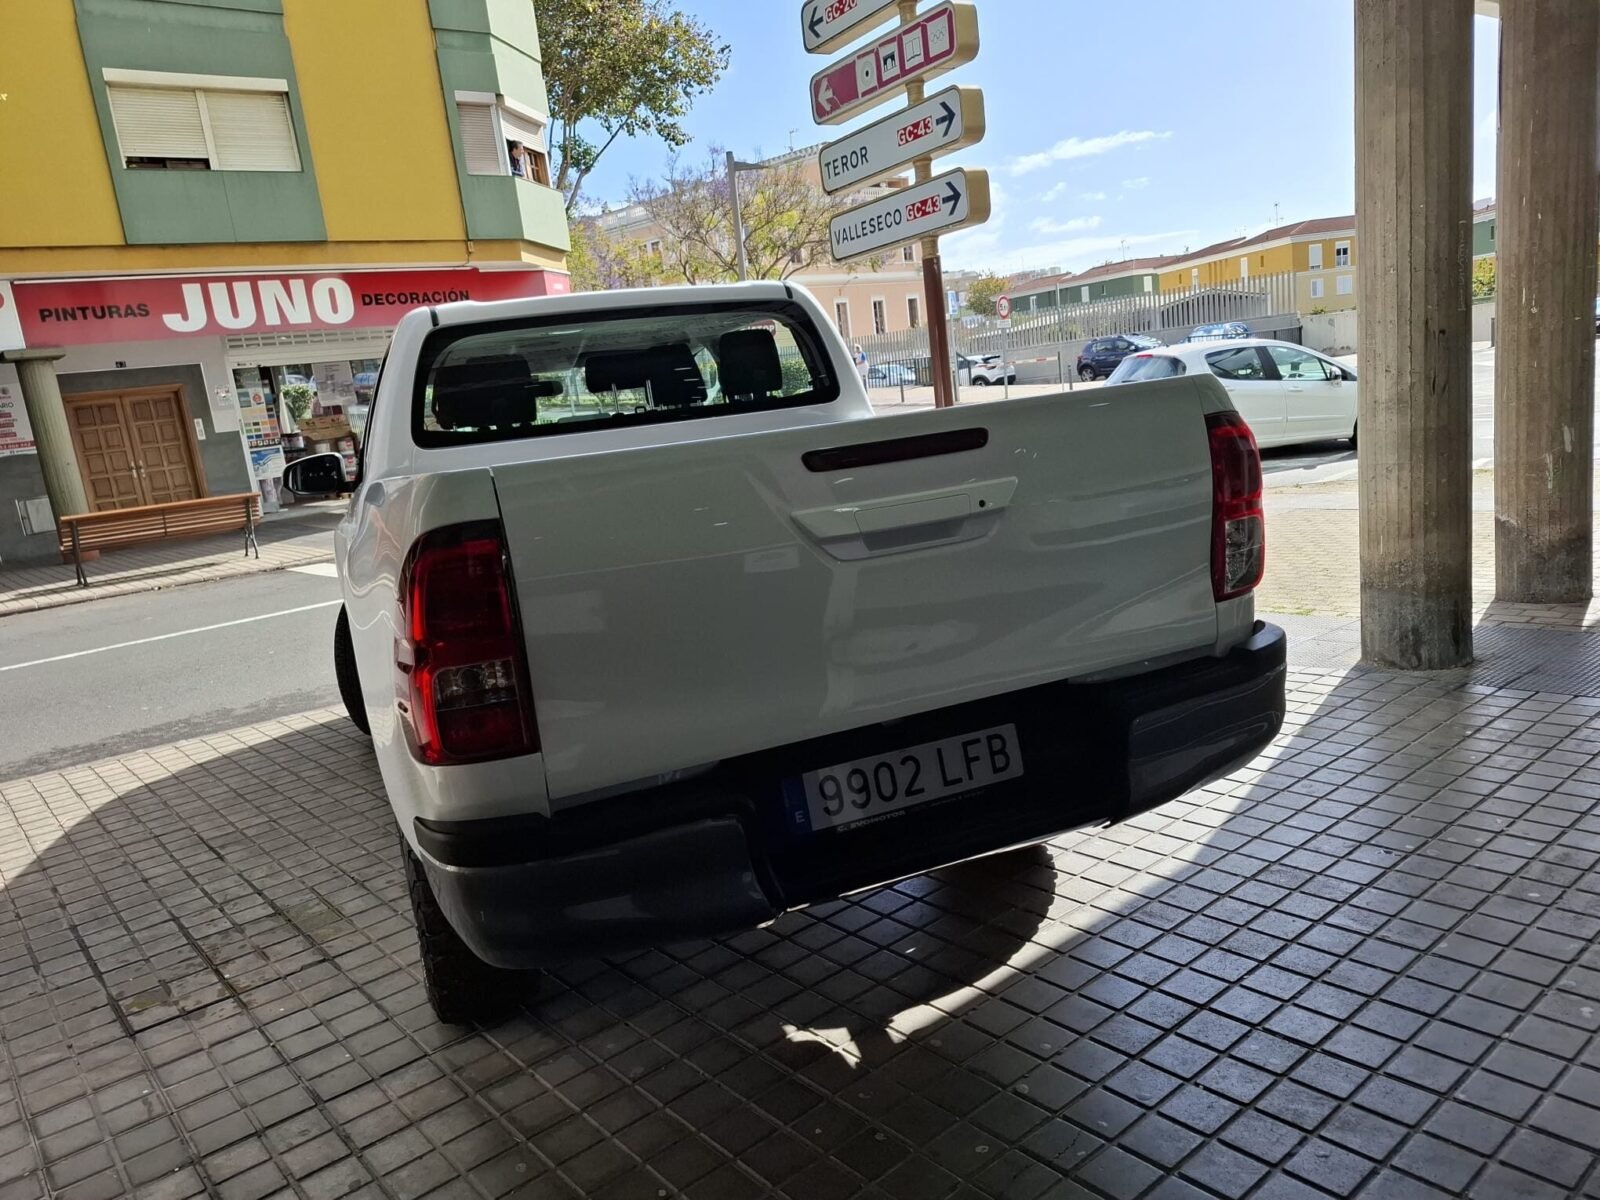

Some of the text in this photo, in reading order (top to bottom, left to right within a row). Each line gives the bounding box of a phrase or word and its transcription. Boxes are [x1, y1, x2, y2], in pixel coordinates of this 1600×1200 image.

[824, 117, 933, 179] TEROR GC-43
[834, 196, 940, 246] VALLESECO GC-43
[38, 277, 470, 333] PINTURAS JUNO DECORACIÓN
[819, 733, 1010, 817] 9902 LFB
[795, 810, 806, 824] E
